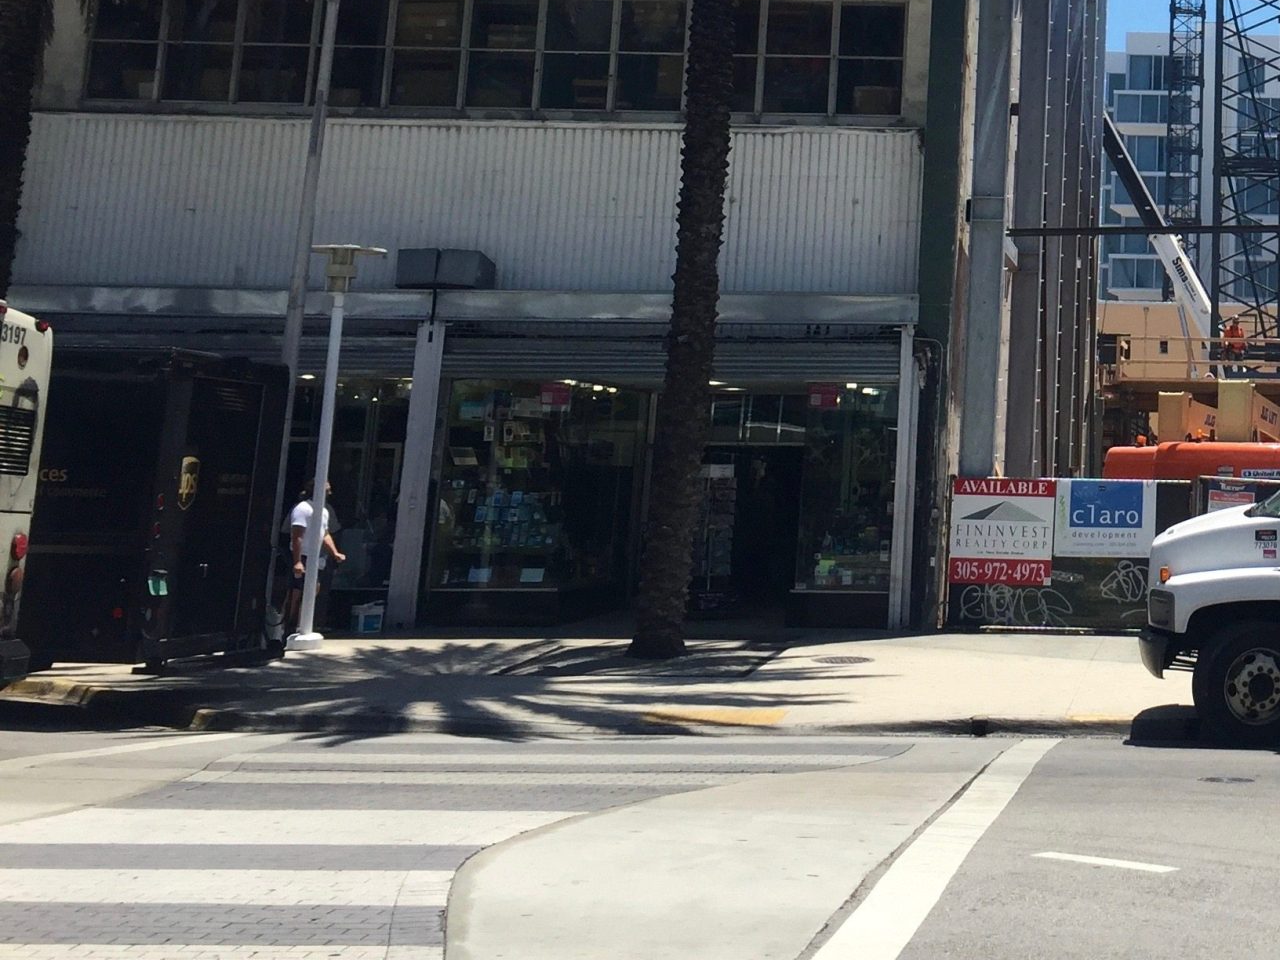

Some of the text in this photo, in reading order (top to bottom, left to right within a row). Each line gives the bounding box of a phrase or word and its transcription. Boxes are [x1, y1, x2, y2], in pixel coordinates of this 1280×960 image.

[1172, 256, 1189, 283] Sims
[1, 323, 26, 346] 3197
[1252, 470, 1275, 478] United
[961, 480, 1049, 495] AVAILABLE
[1072, 504, 1139, 525] claro
[956, 524, 1050, 539] FININVEST
[1071, 530, 1137, 540] development
[956, 539, 1048, 550] REALTY CORP
